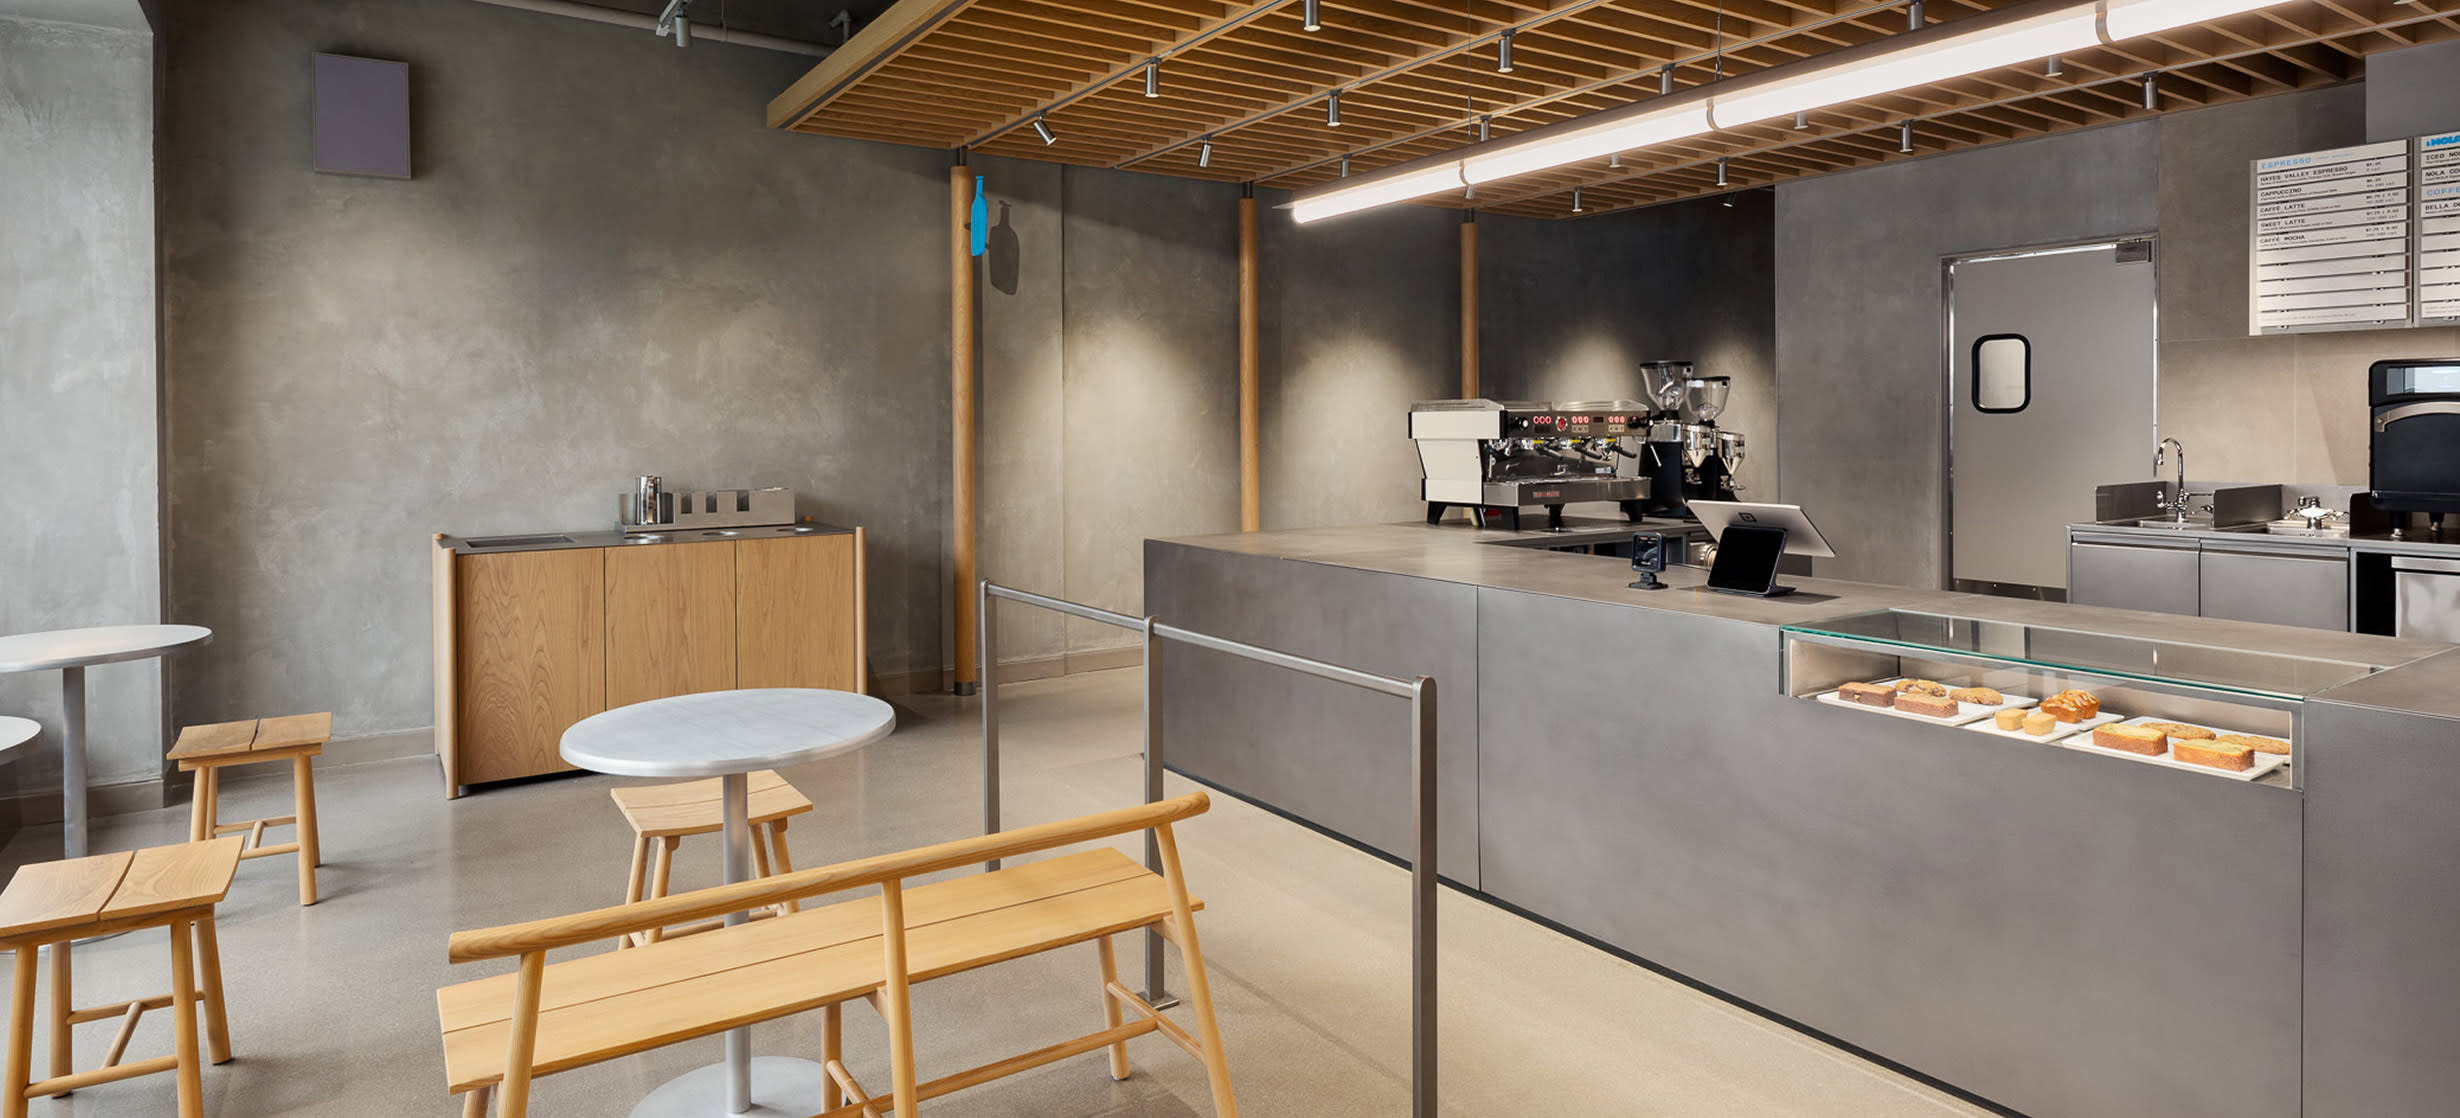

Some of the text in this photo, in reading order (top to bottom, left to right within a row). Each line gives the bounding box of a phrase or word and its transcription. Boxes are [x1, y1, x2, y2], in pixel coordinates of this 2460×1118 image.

[2261, 157, 2312, 169] ESPRESSO
[2284, 172, 2310, 180] VALLEY
[2314, 166, 2348, 176] ESPRESSO
[2260, 188, 2302, 197] CAPPUCCINO
